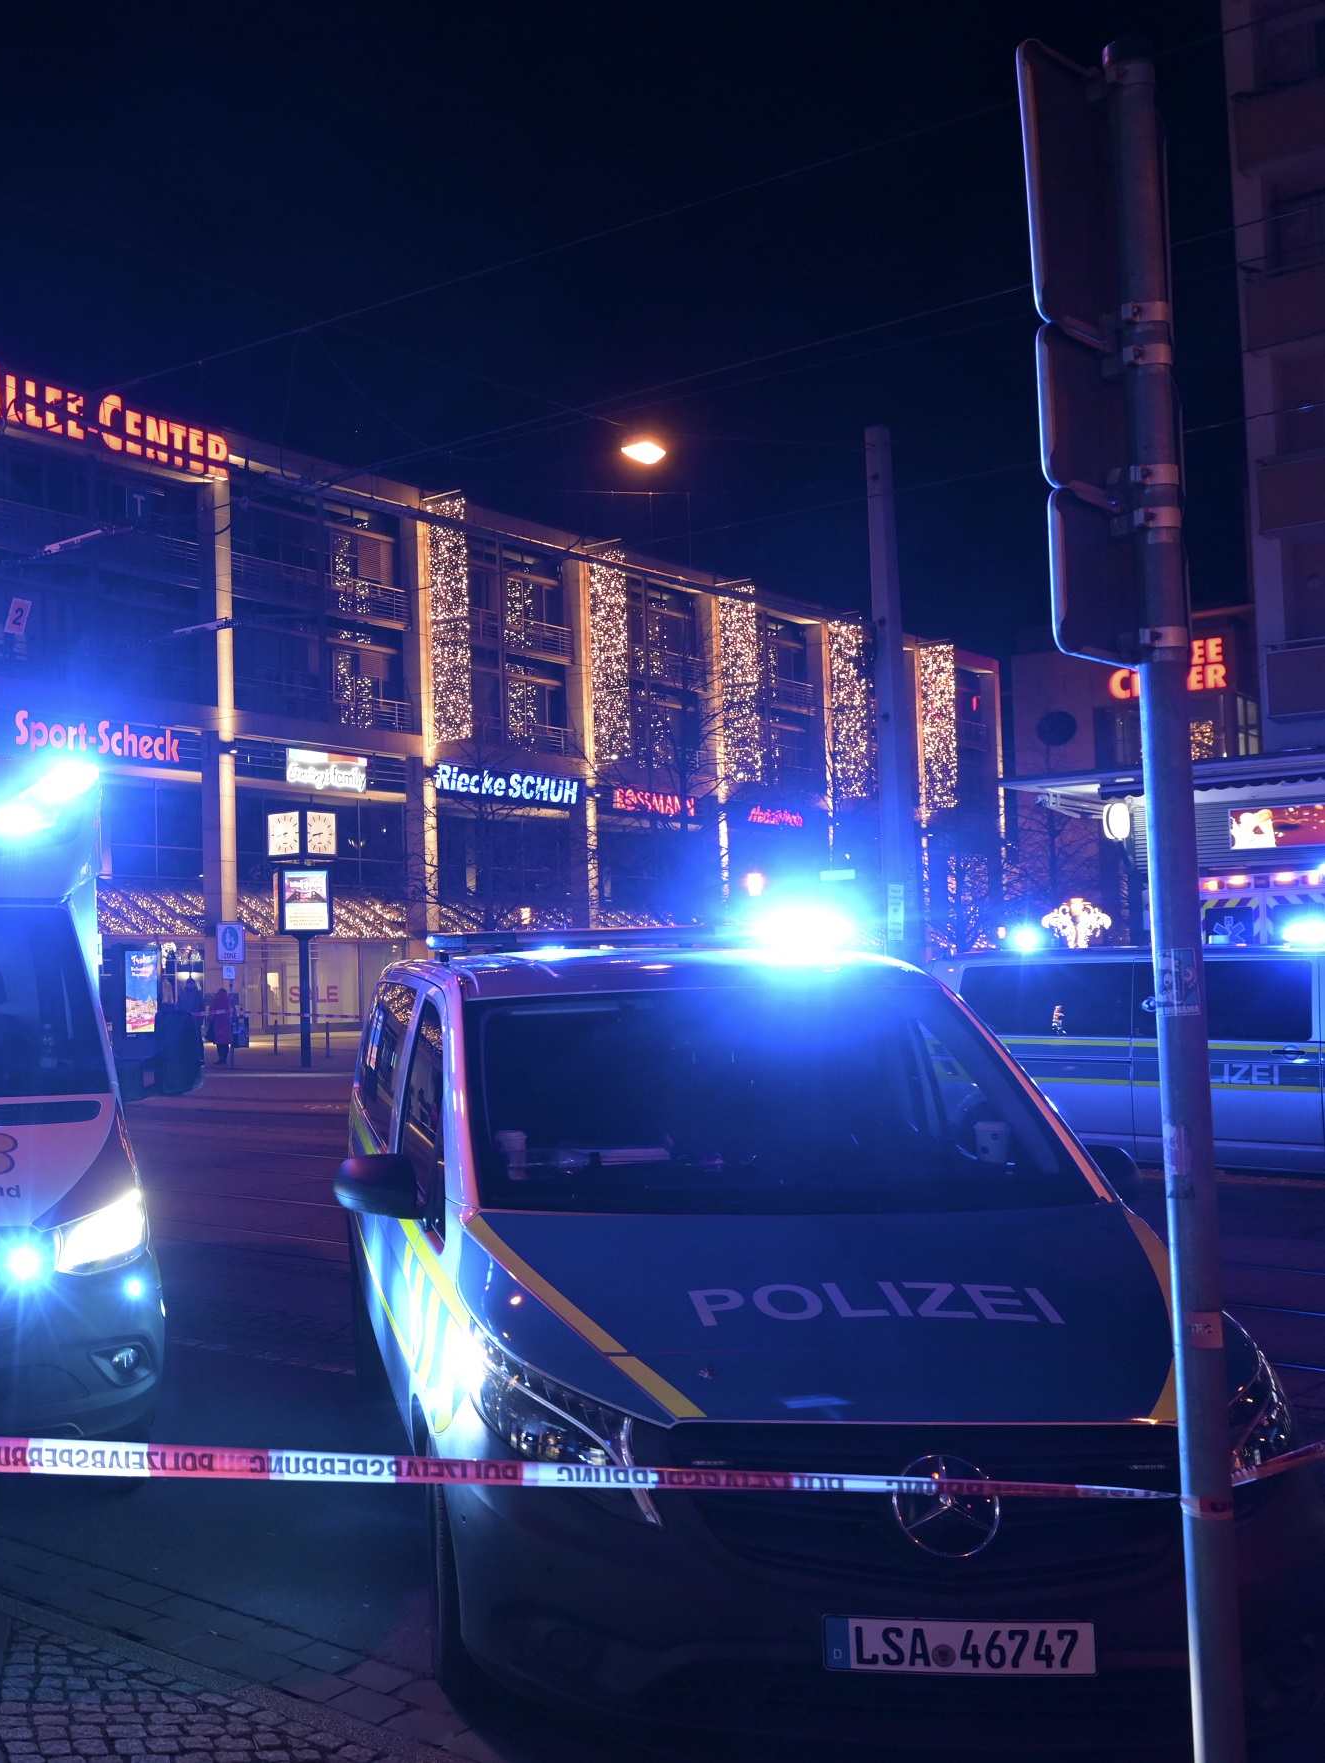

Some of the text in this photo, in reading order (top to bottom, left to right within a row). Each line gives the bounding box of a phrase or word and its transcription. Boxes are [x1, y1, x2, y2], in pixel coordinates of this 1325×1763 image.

[12, 607, 24, 625] 2
[15, 709, 180, 763] Sport-Scheck
[434, 763, 579, 805] Riecke SCHUH
[288, 985, 339, 1004] SLE
[1210, 1063, 1280, 1086] IZEI
[688, 1281, 1066, 1327] POLIZEI
[855, 1625, 931, 1667] LSA
[960, 1629, 1079, 1669] 46747
